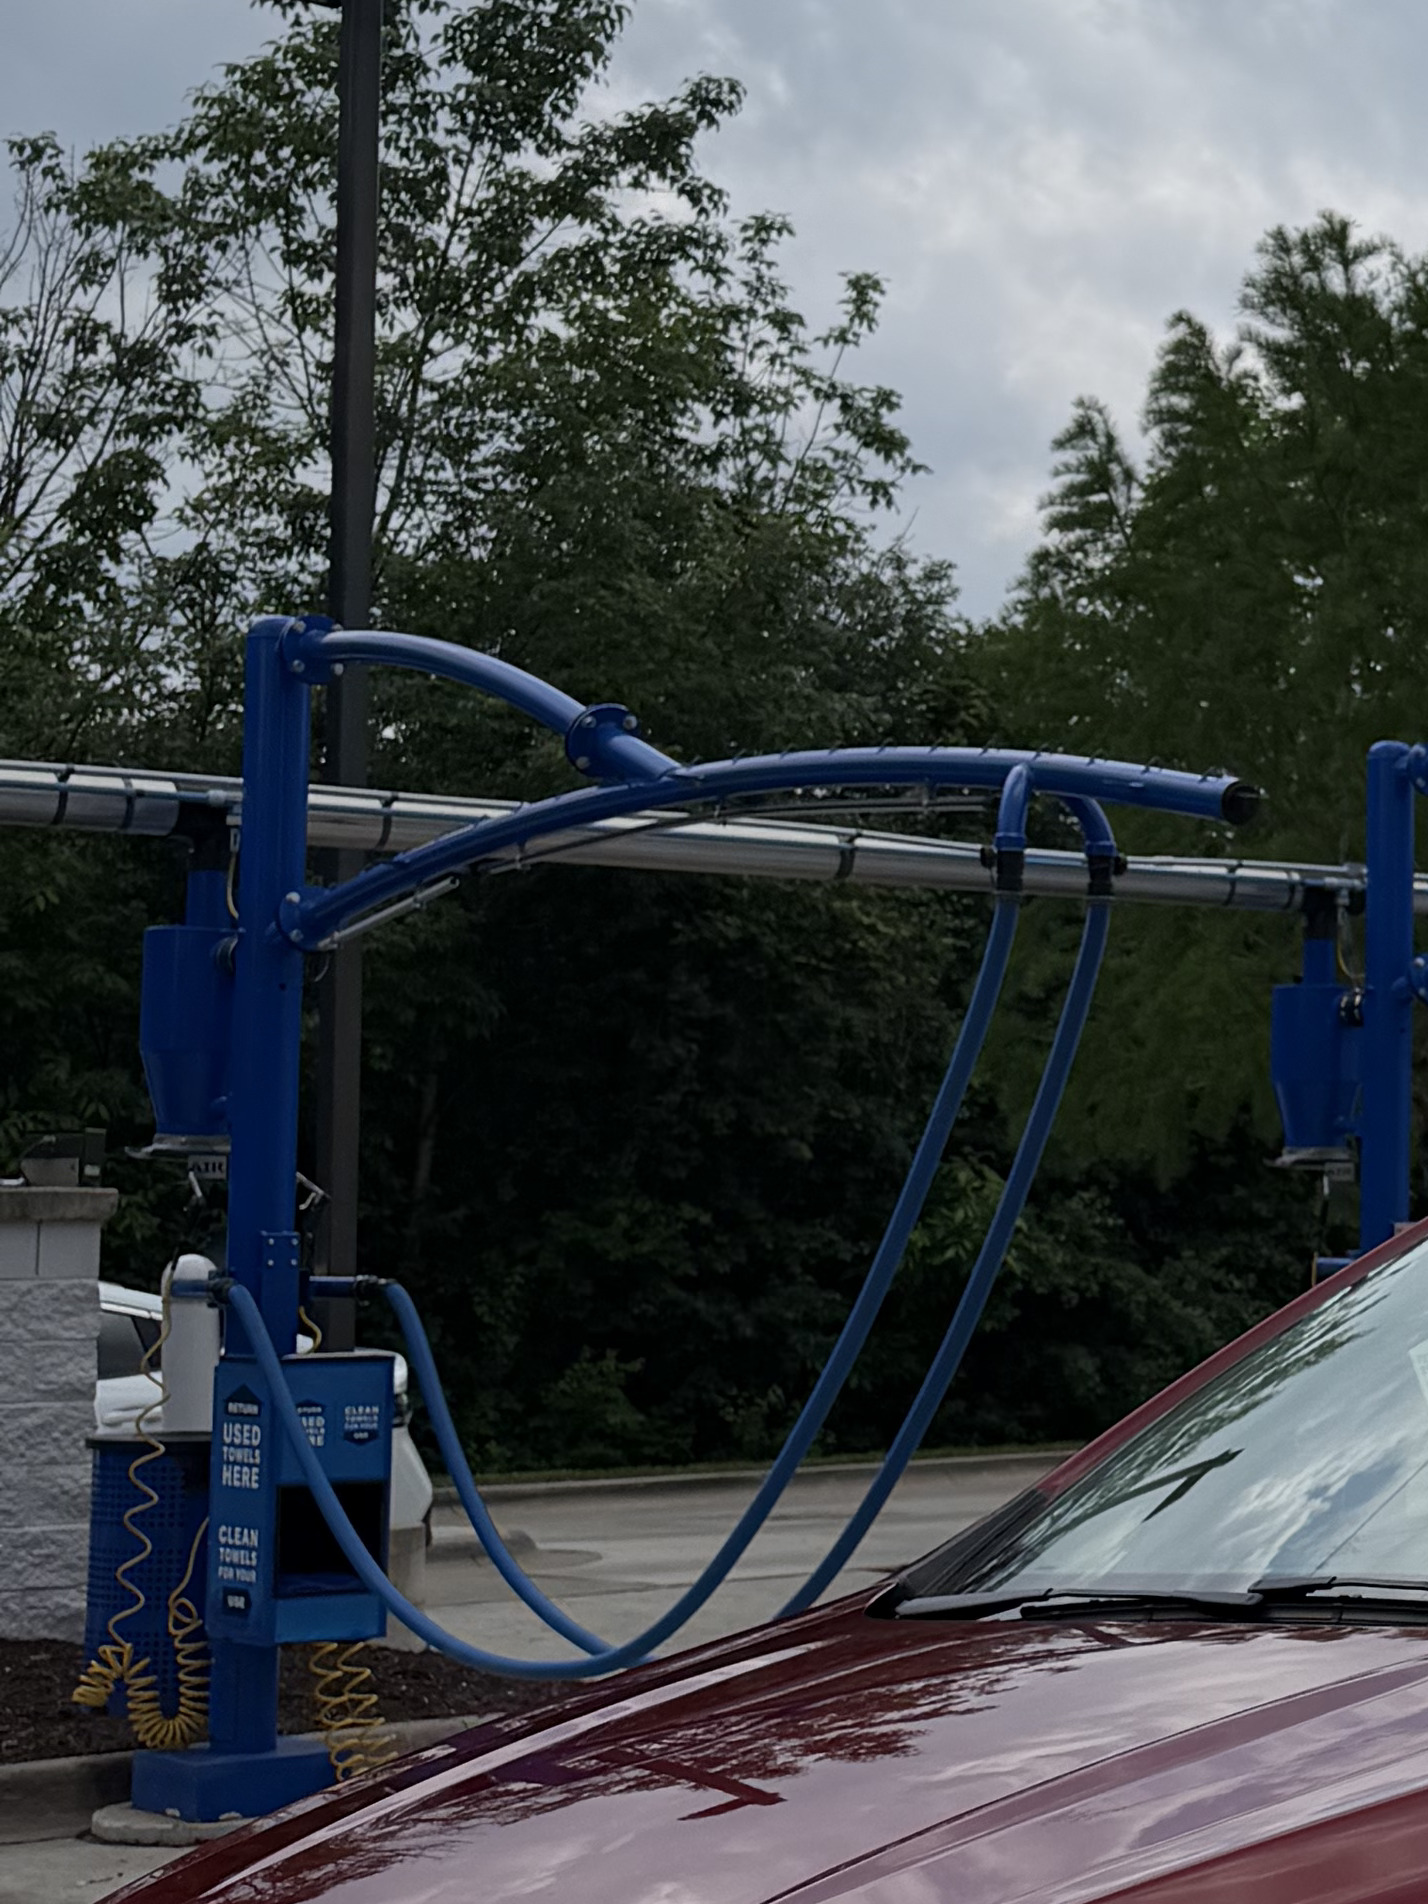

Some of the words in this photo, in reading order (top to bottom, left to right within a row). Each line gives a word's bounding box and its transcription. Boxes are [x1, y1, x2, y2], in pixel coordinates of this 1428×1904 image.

[191, 1162, 223, 1173] AIR
[344, 1405, 379, 1415] CLEAN
[222, 1422, 262, 1446] USED
[222, 1446, 261, 1464] TOWELS
[222, 1464, 260, 1488] HERE
[219, 1525, 258, 1547] CLEAN
[219, 1548, 257, 1566] TOWELS
[218, 1566, 233, 1580] FOR
[236, 1569, 256, 1583] YOUR
